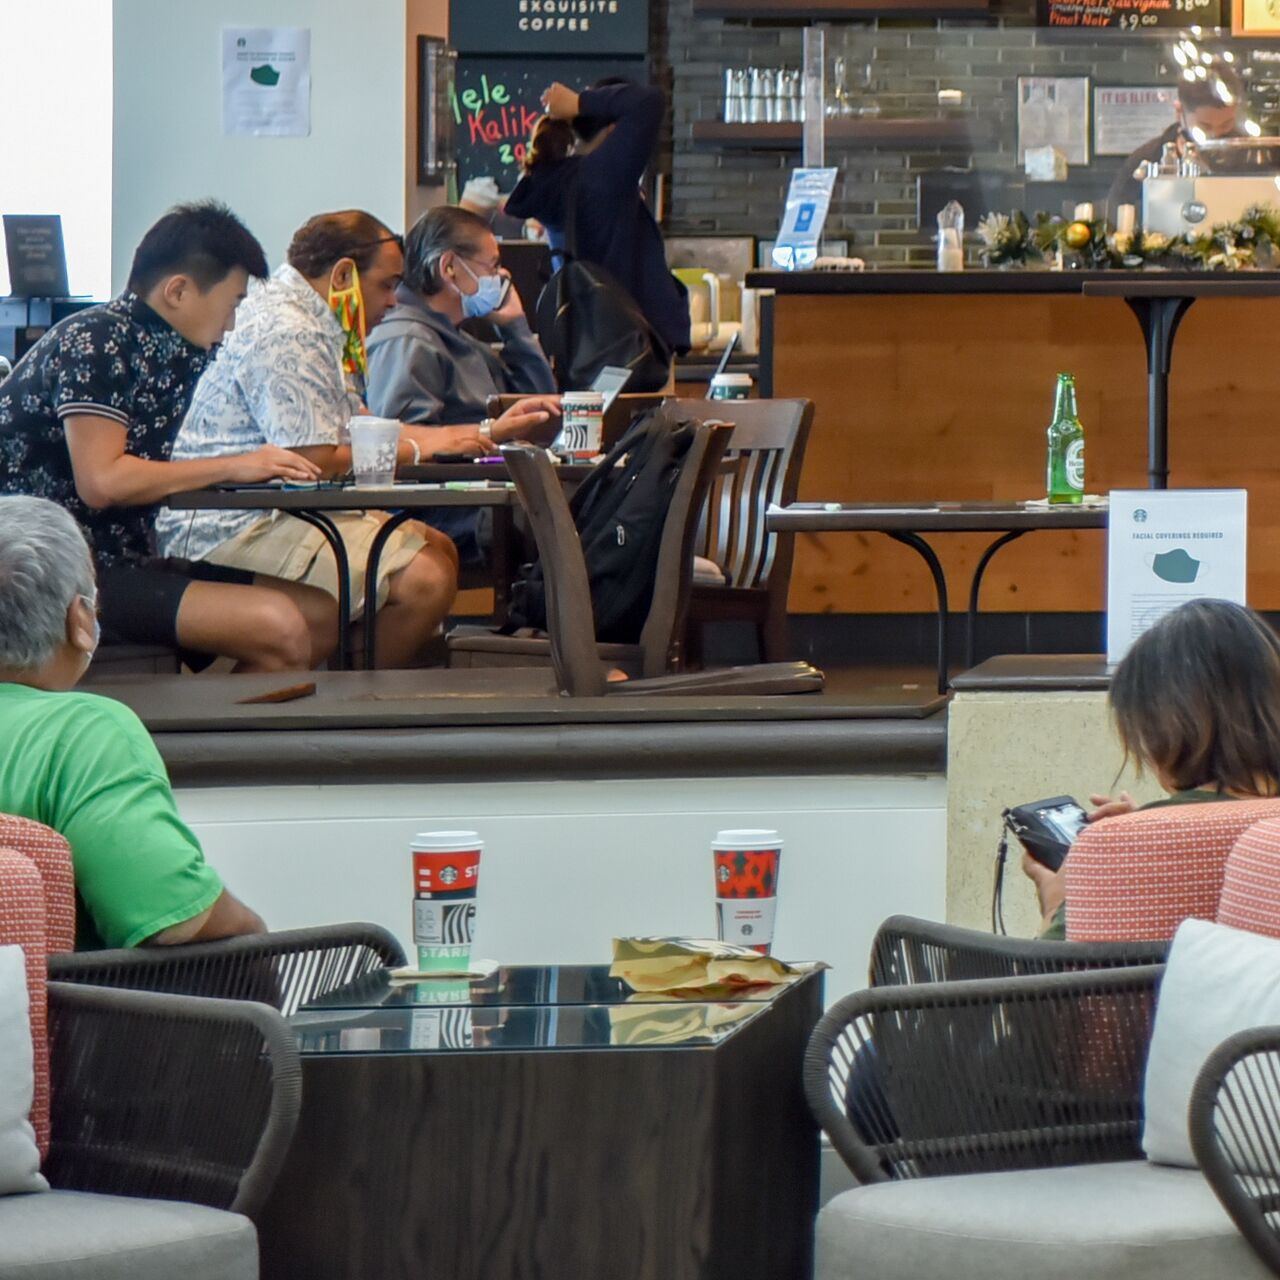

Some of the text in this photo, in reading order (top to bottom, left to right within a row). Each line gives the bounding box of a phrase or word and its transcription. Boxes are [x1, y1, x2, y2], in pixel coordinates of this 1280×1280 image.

[519, 0, 618, 13] EXQUISITE
[518, 17, 590, 32] COFFEE
[1050, 13, 1079, 27] Pinot
[1082, 13, 1110, 27] Noir
[1132, 531, 1224, 540] FACIAL COVERINGS REQUIRED
